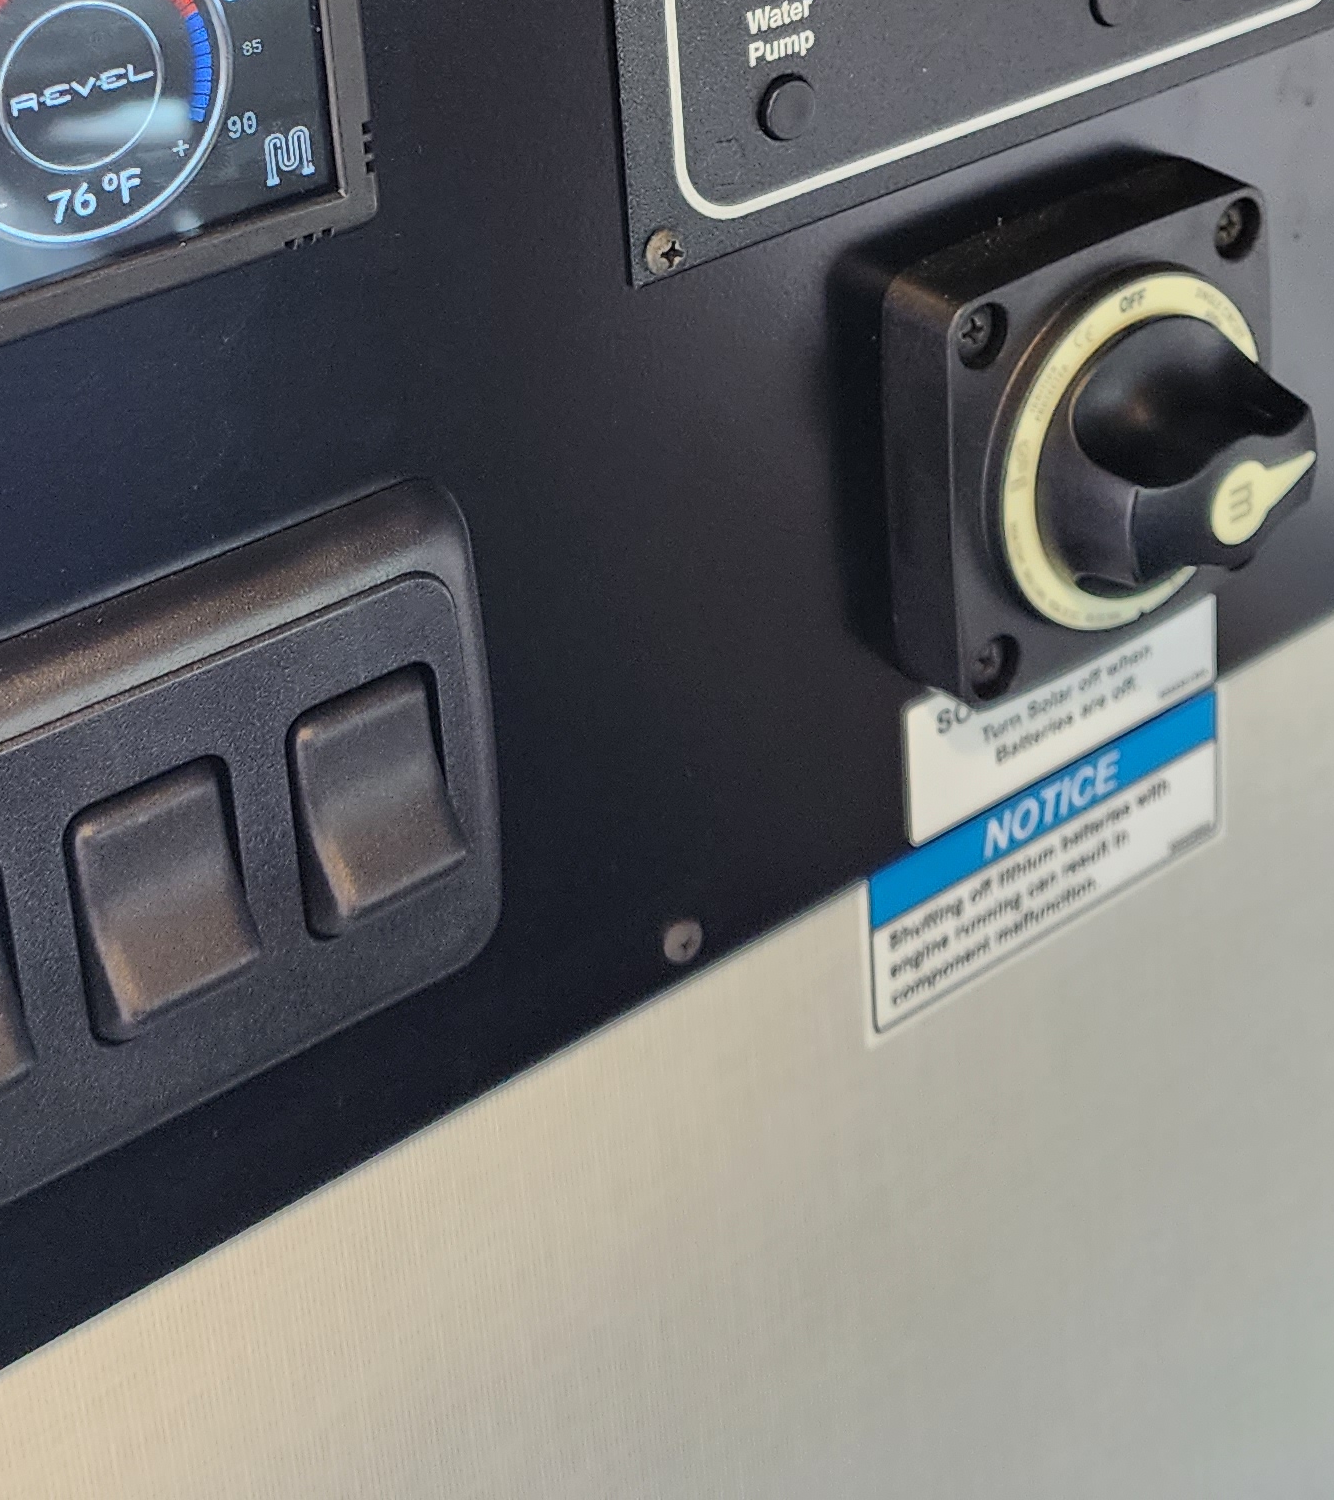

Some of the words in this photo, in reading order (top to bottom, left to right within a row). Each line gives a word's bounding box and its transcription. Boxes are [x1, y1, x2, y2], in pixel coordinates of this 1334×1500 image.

[242, 38, 263, 56] 85
[747, 29, 816, 67] Pump
[10, 63, 155, 117] REVEL
[226, 112, 258, 139] 90
[47, 188, 98, 225] 76
[1119, 287, 1148, 313] OFF
[982, 713, 1023, 744] Turn
[1027, 687, 1073, 720] Solar
[1078, 666, 1103, 693] off
[1106, 645, 1154, 677] when
[994, 712, 1075, 765] Batteries
[1079, 695, 1107, 719] are
[983, 750, 1122, 861] NOTICE
[888, 900, 964, 950] Shutting
[969, 876, 993, 906] off
[997, 845, 1056, 890] lithium
[1060, 803, 1131, 852] batteries
[1136, 778, 1171, 809] with
[889, 935, 950, 979] engine
[954, 894, 1023, 940] running
[1027, 870, 1058, 899] can
[1061, 838, 1110, 879] result
[1112, 828, 1131, 851] in
[891, 935, 992, 1006] component
